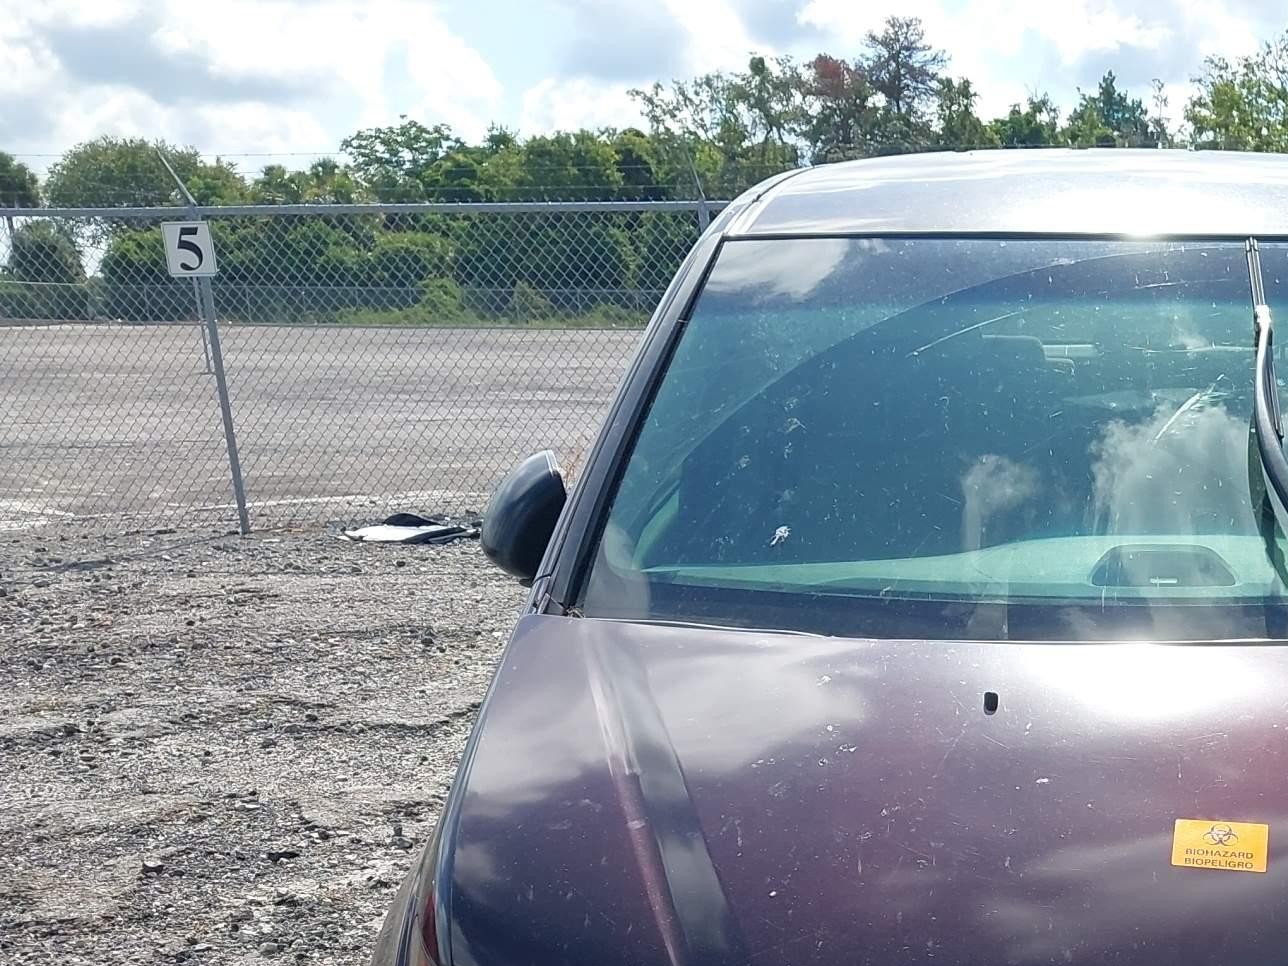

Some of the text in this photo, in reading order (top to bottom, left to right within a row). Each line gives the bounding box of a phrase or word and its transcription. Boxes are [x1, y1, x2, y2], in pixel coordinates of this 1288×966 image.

[177, 227, 203, 271] 5
[1185, 848, 1254, 859] BIOHAZARD
[1184, 858, 1254, 870] BIOPELIGRO
